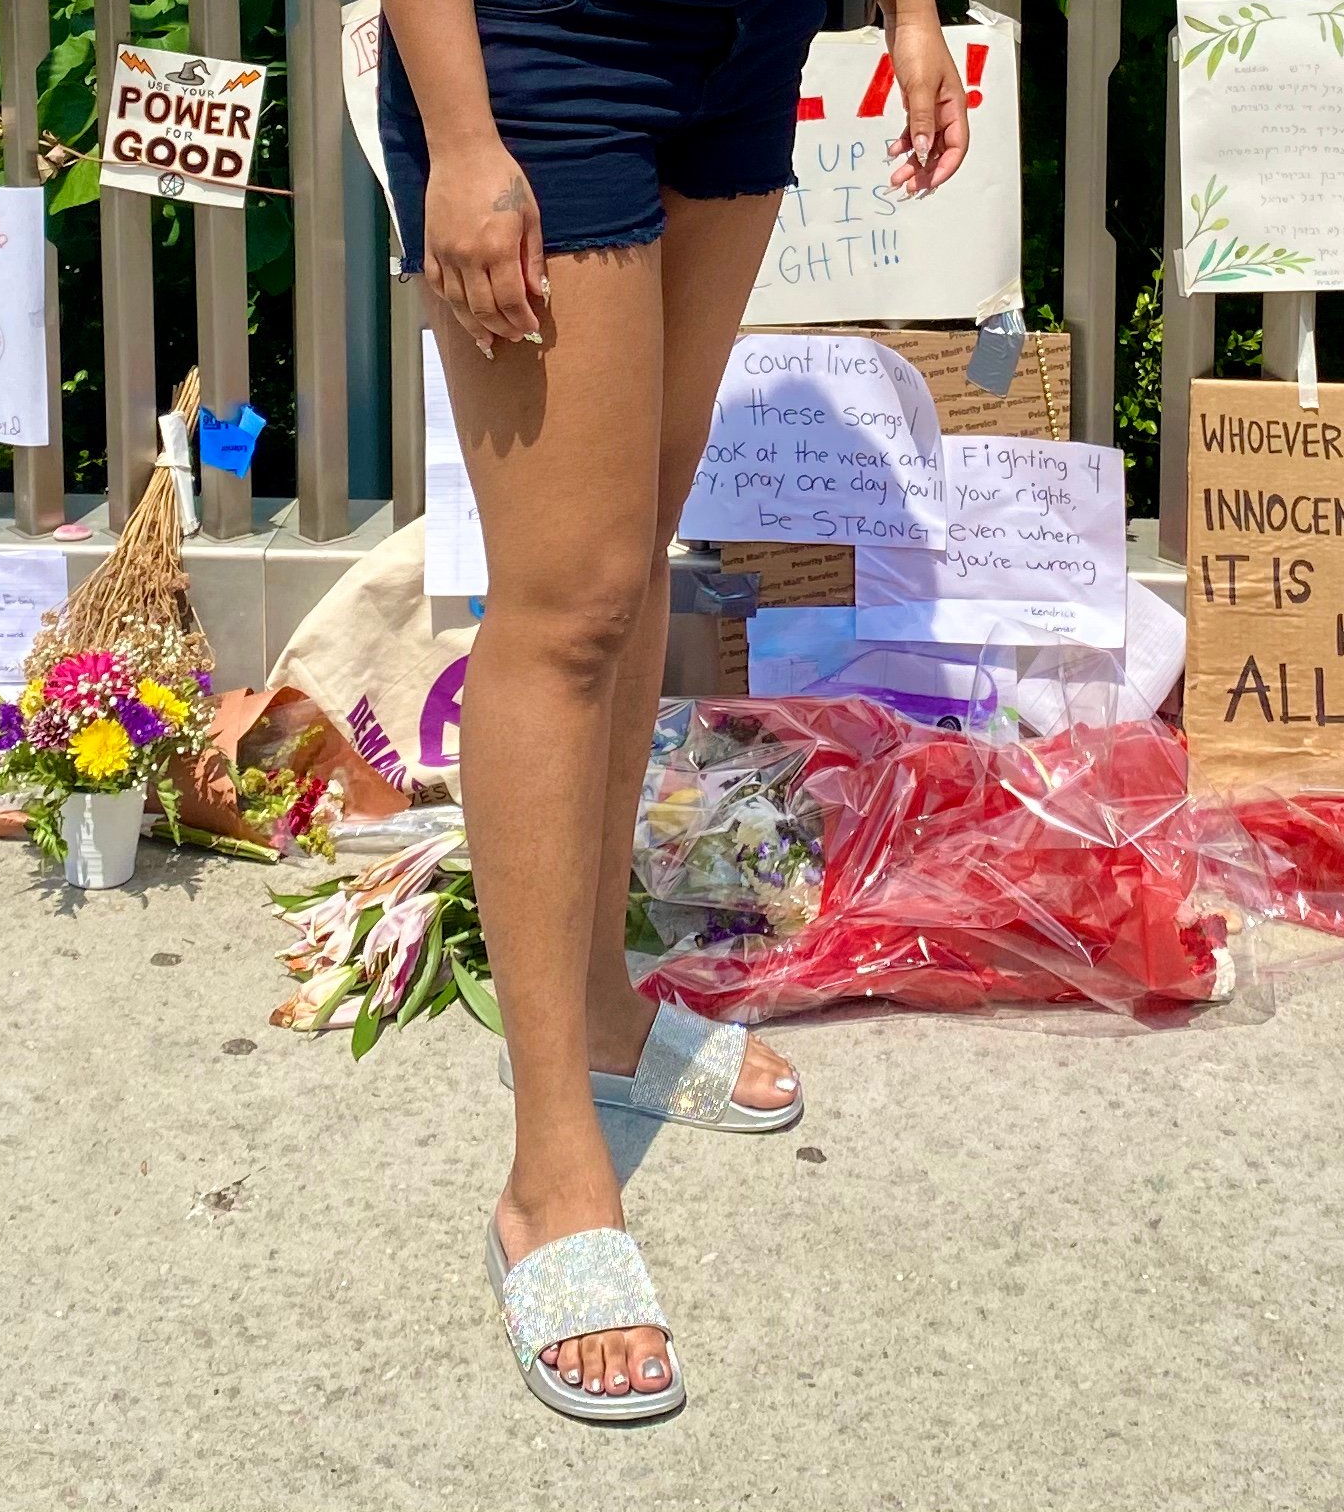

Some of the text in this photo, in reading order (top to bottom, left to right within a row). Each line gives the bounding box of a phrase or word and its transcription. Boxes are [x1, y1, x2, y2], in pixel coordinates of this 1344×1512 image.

[148, 81, 215, 98] USE YOUR
[117, 85, 251, 140] POWER
[166, 127, 193, 141] FOR
[113, 129, 243, 178] GOOD
[819, 142, 865, 172] UP
[833, 185, 896, 223] IS
[745, 344, 813, 376] count
[750, 388, 825, 426] these
[1200, 413, 1343, 460] WHOEVER
[757, 441, 937, 471] at the weak and
[962, 443, 1101, 494] Fighting 4
[735, 476, 785, 499] pray
[796, 474, 836, 492] one
[850, 476, 887, 504] day
[956, 486, 1002, 507] your
[758, 506, 928, 542] be STRONG
[948, 522, 1080, 545] even when
[946, 551, 1096, 585] you're wrong
[1201, 554, 1250, 605] IT
[1272, 556, 1315, 610] IS
